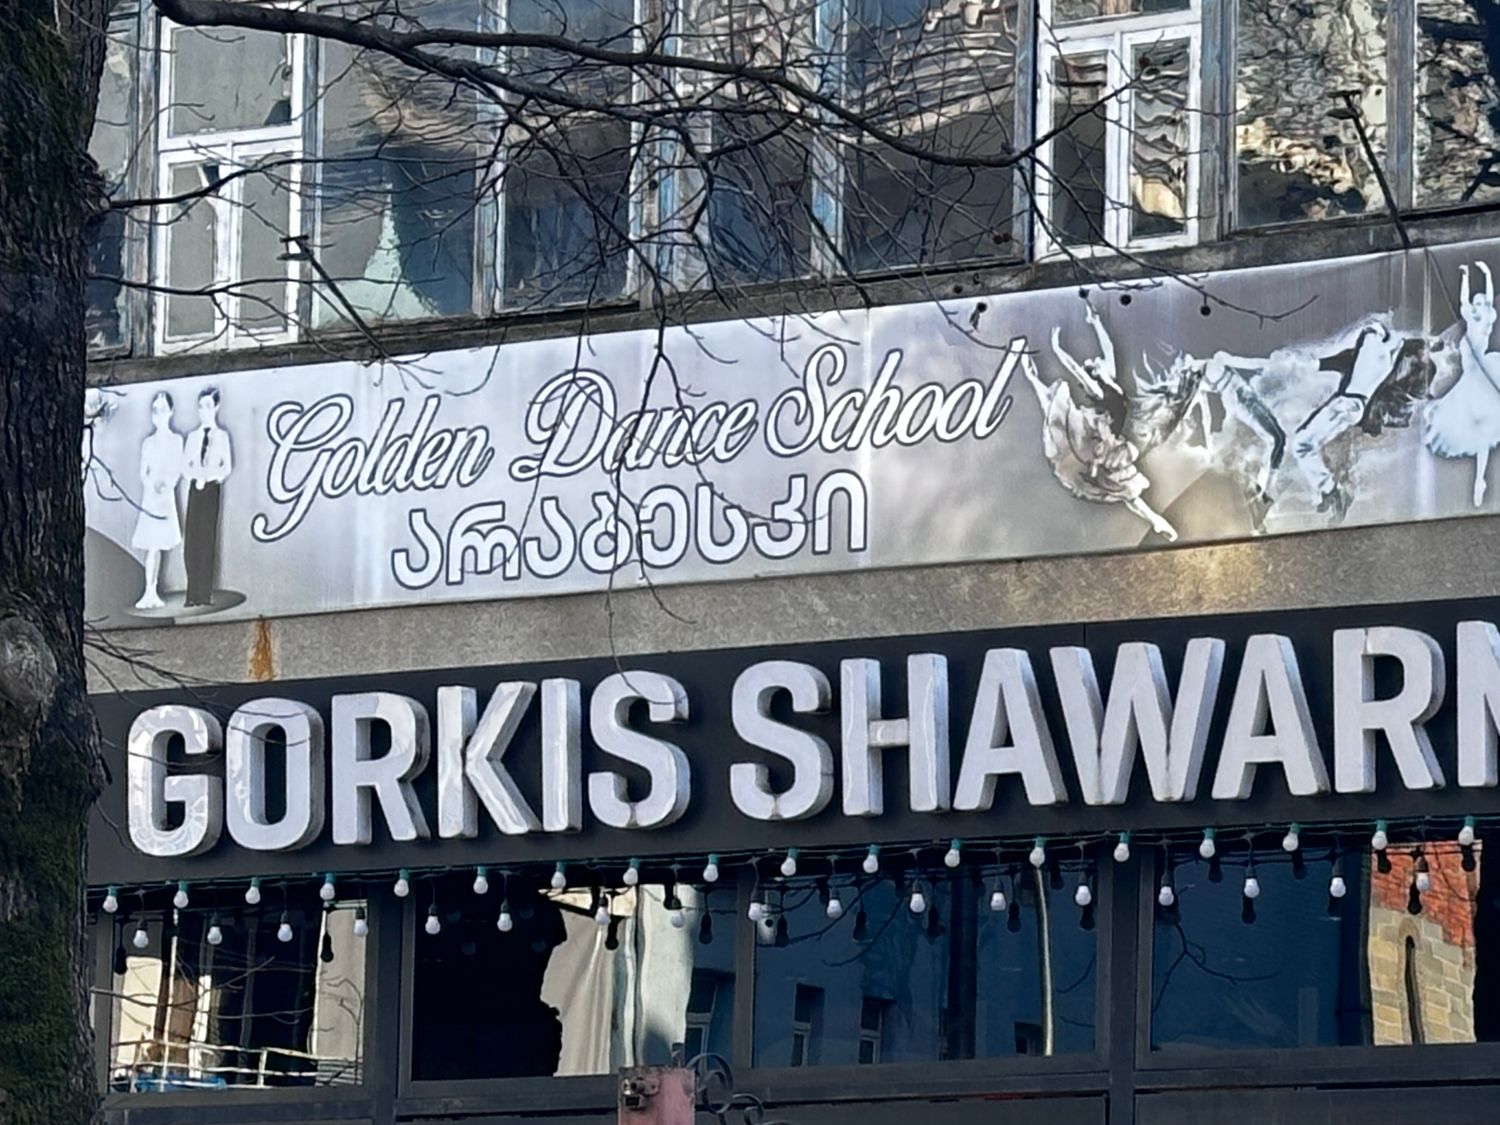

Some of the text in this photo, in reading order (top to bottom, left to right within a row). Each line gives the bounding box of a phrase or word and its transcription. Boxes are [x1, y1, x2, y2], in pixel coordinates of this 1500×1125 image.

[251, 336, 1028, 542] Golden Dance School
[390, 469, 869, 590] არაბესკი
[126, 668, 691, 858] GORKIS
